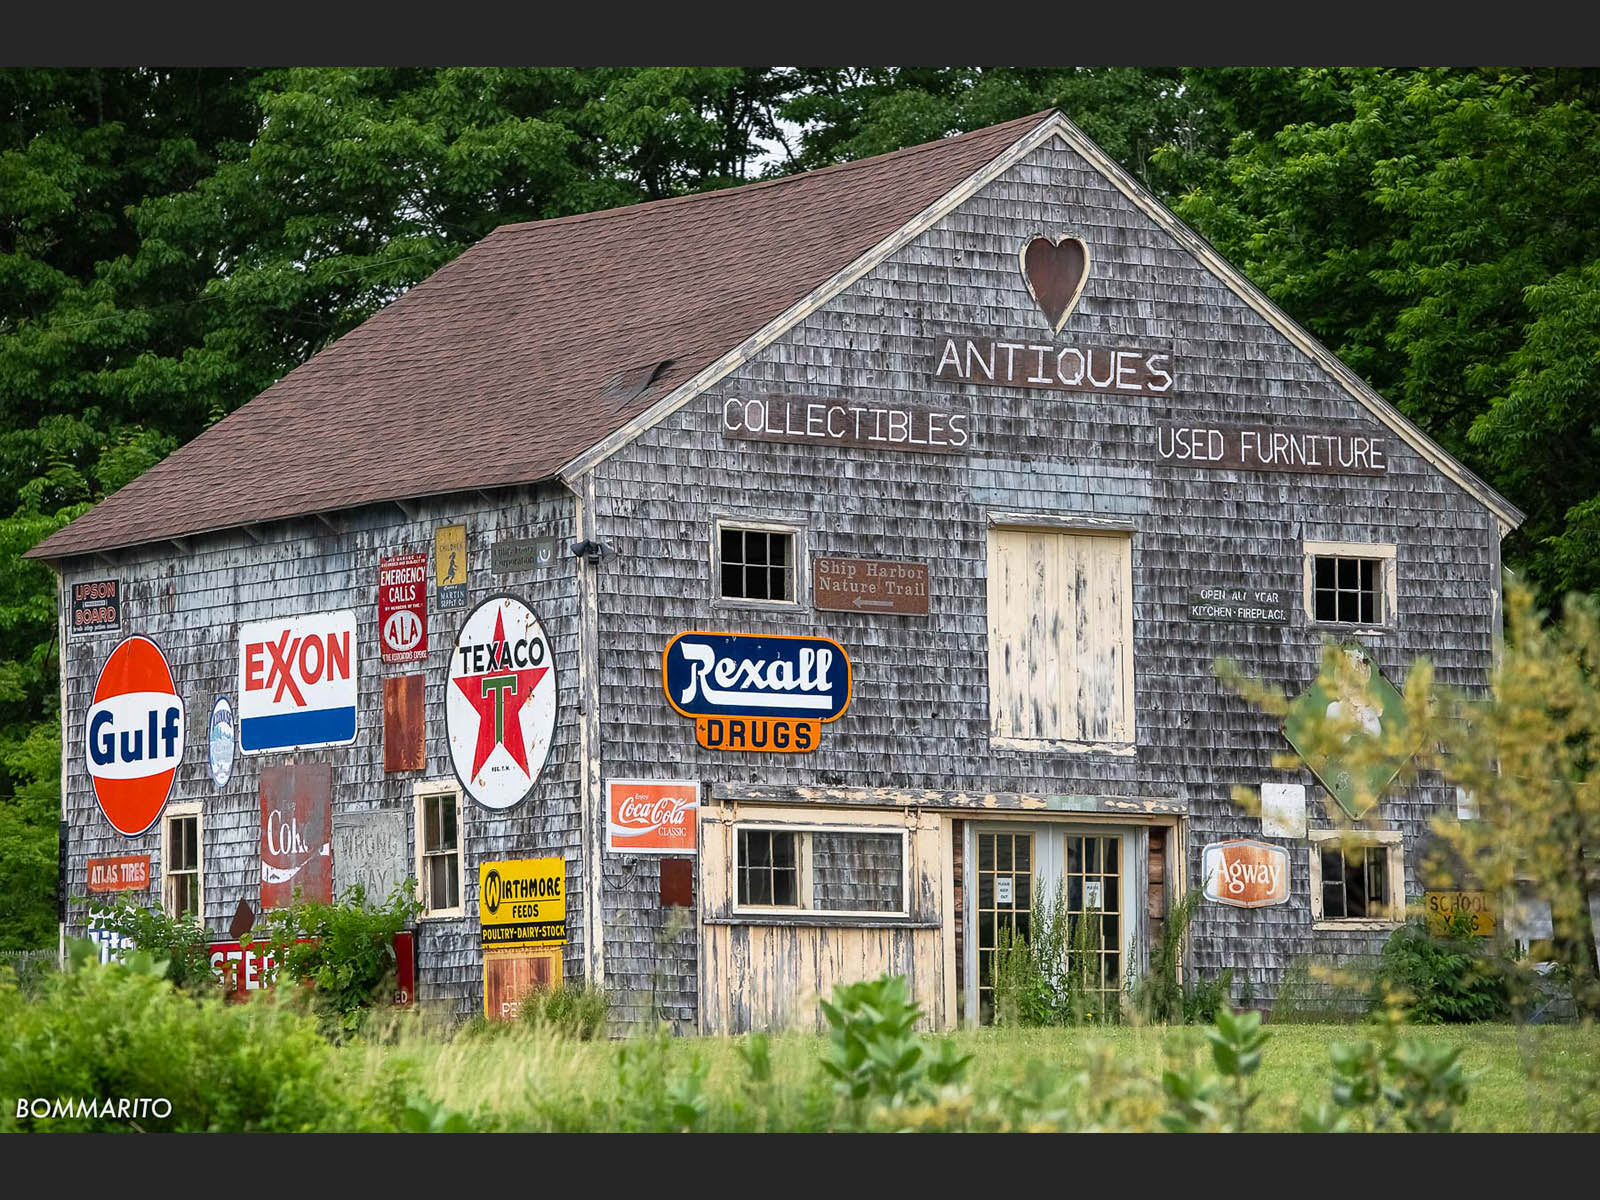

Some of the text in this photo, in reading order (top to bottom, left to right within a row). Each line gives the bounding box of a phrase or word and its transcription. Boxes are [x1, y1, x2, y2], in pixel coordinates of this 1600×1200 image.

[935, 338, 1174, 392] ANTIQUES
[723, 397, 968, 447] COLLECTIBLES
[1158, 427, 1386, 469] USED FURNITURE
[380, 566, 426, 586] EMERGENCY
[819, 560, 924, 579] Ship Harbor
[388, 584, 415, 602] CALLS
[819, 576, 926, 596] Nature Trail
[1200, 588, 1226, 600] OPEN
[1254, 591, 1279, 603] YEAR
[74, 607, 117, 625] BOARD
[388, 615, 418, 645] ALA
[245, 629, 350, 707] EXXON
[460, 637, 544, 675] TEXACO
[680, 641, 833, 710] Rexall
[89, 706, 181, 766] Gulf
[707, 719, 812, 749] DRUGS
[618, 796, 688, 825] Coca-Cola
[634, 793, 649, 802] Enjoy
[267, 808, 309, 857] Cok
[657, 826, 687, 837] CLASSIC
[91, 862, 146, 885] ATLAS TIRES
[1212, 849, 1281, 896] Agway
[512, 904, 539, 918] FEEDS
[1430, 895, 1489, 913] SCHOOL
